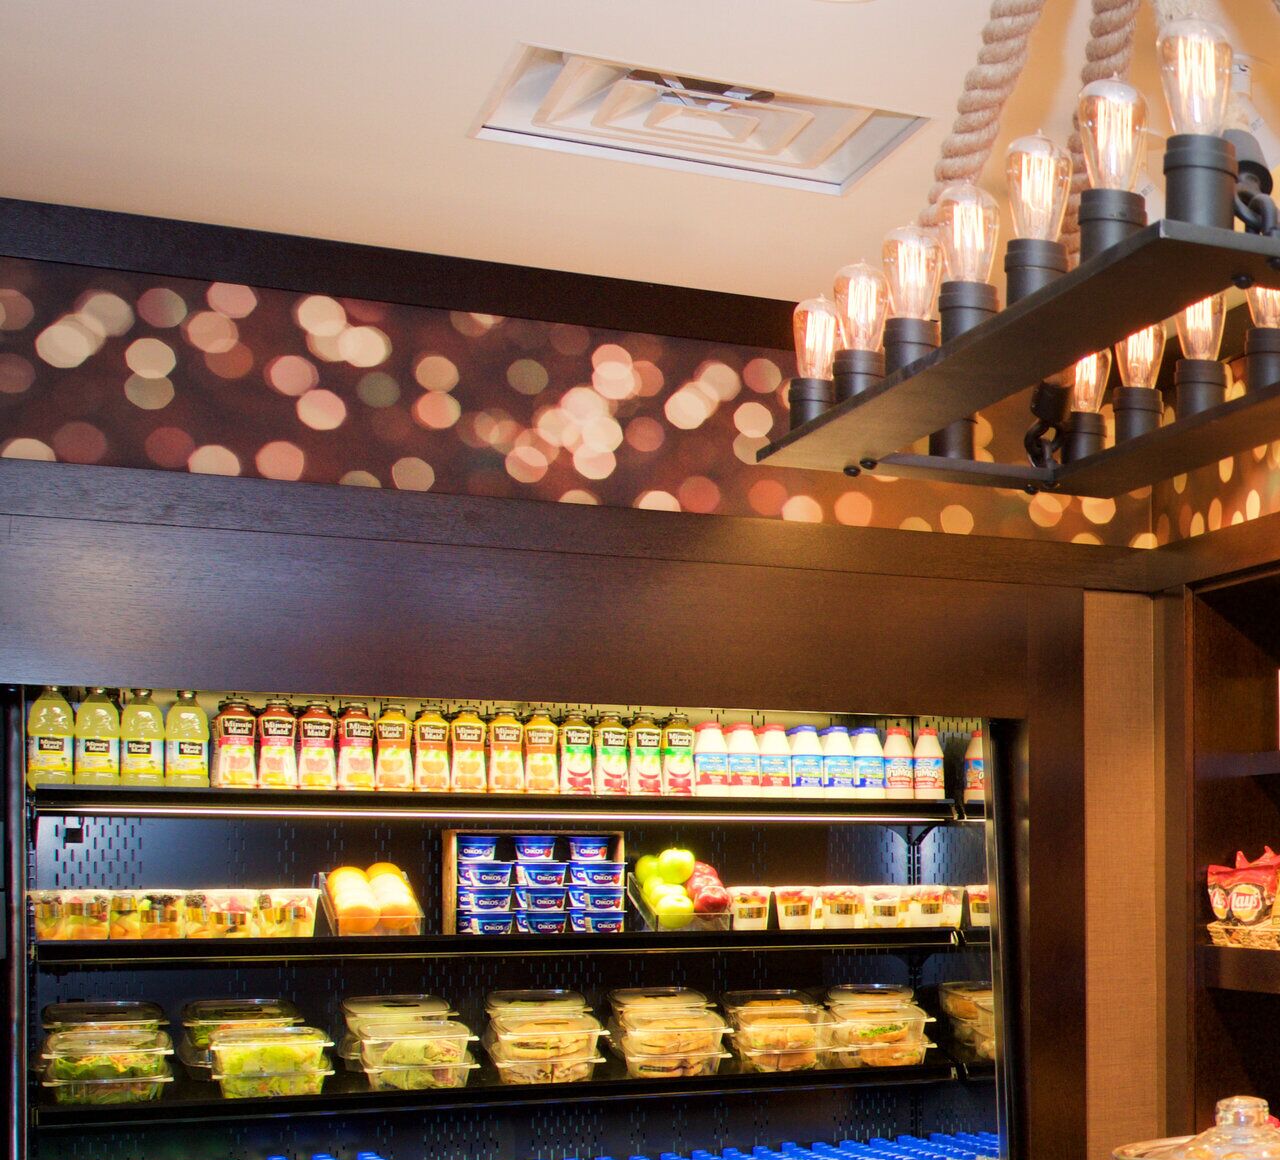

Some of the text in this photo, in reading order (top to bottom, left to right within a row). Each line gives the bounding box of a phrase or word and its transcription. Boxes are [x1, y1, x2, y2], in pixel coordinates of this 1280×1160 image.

[224, 720, 252, 729] Minute
[265, 721, 292, 729] Minute
[304, 722, 329, 731] Minute
[349, 722, 373, 730] Minute
[379, 724, 403, 732] Minute
